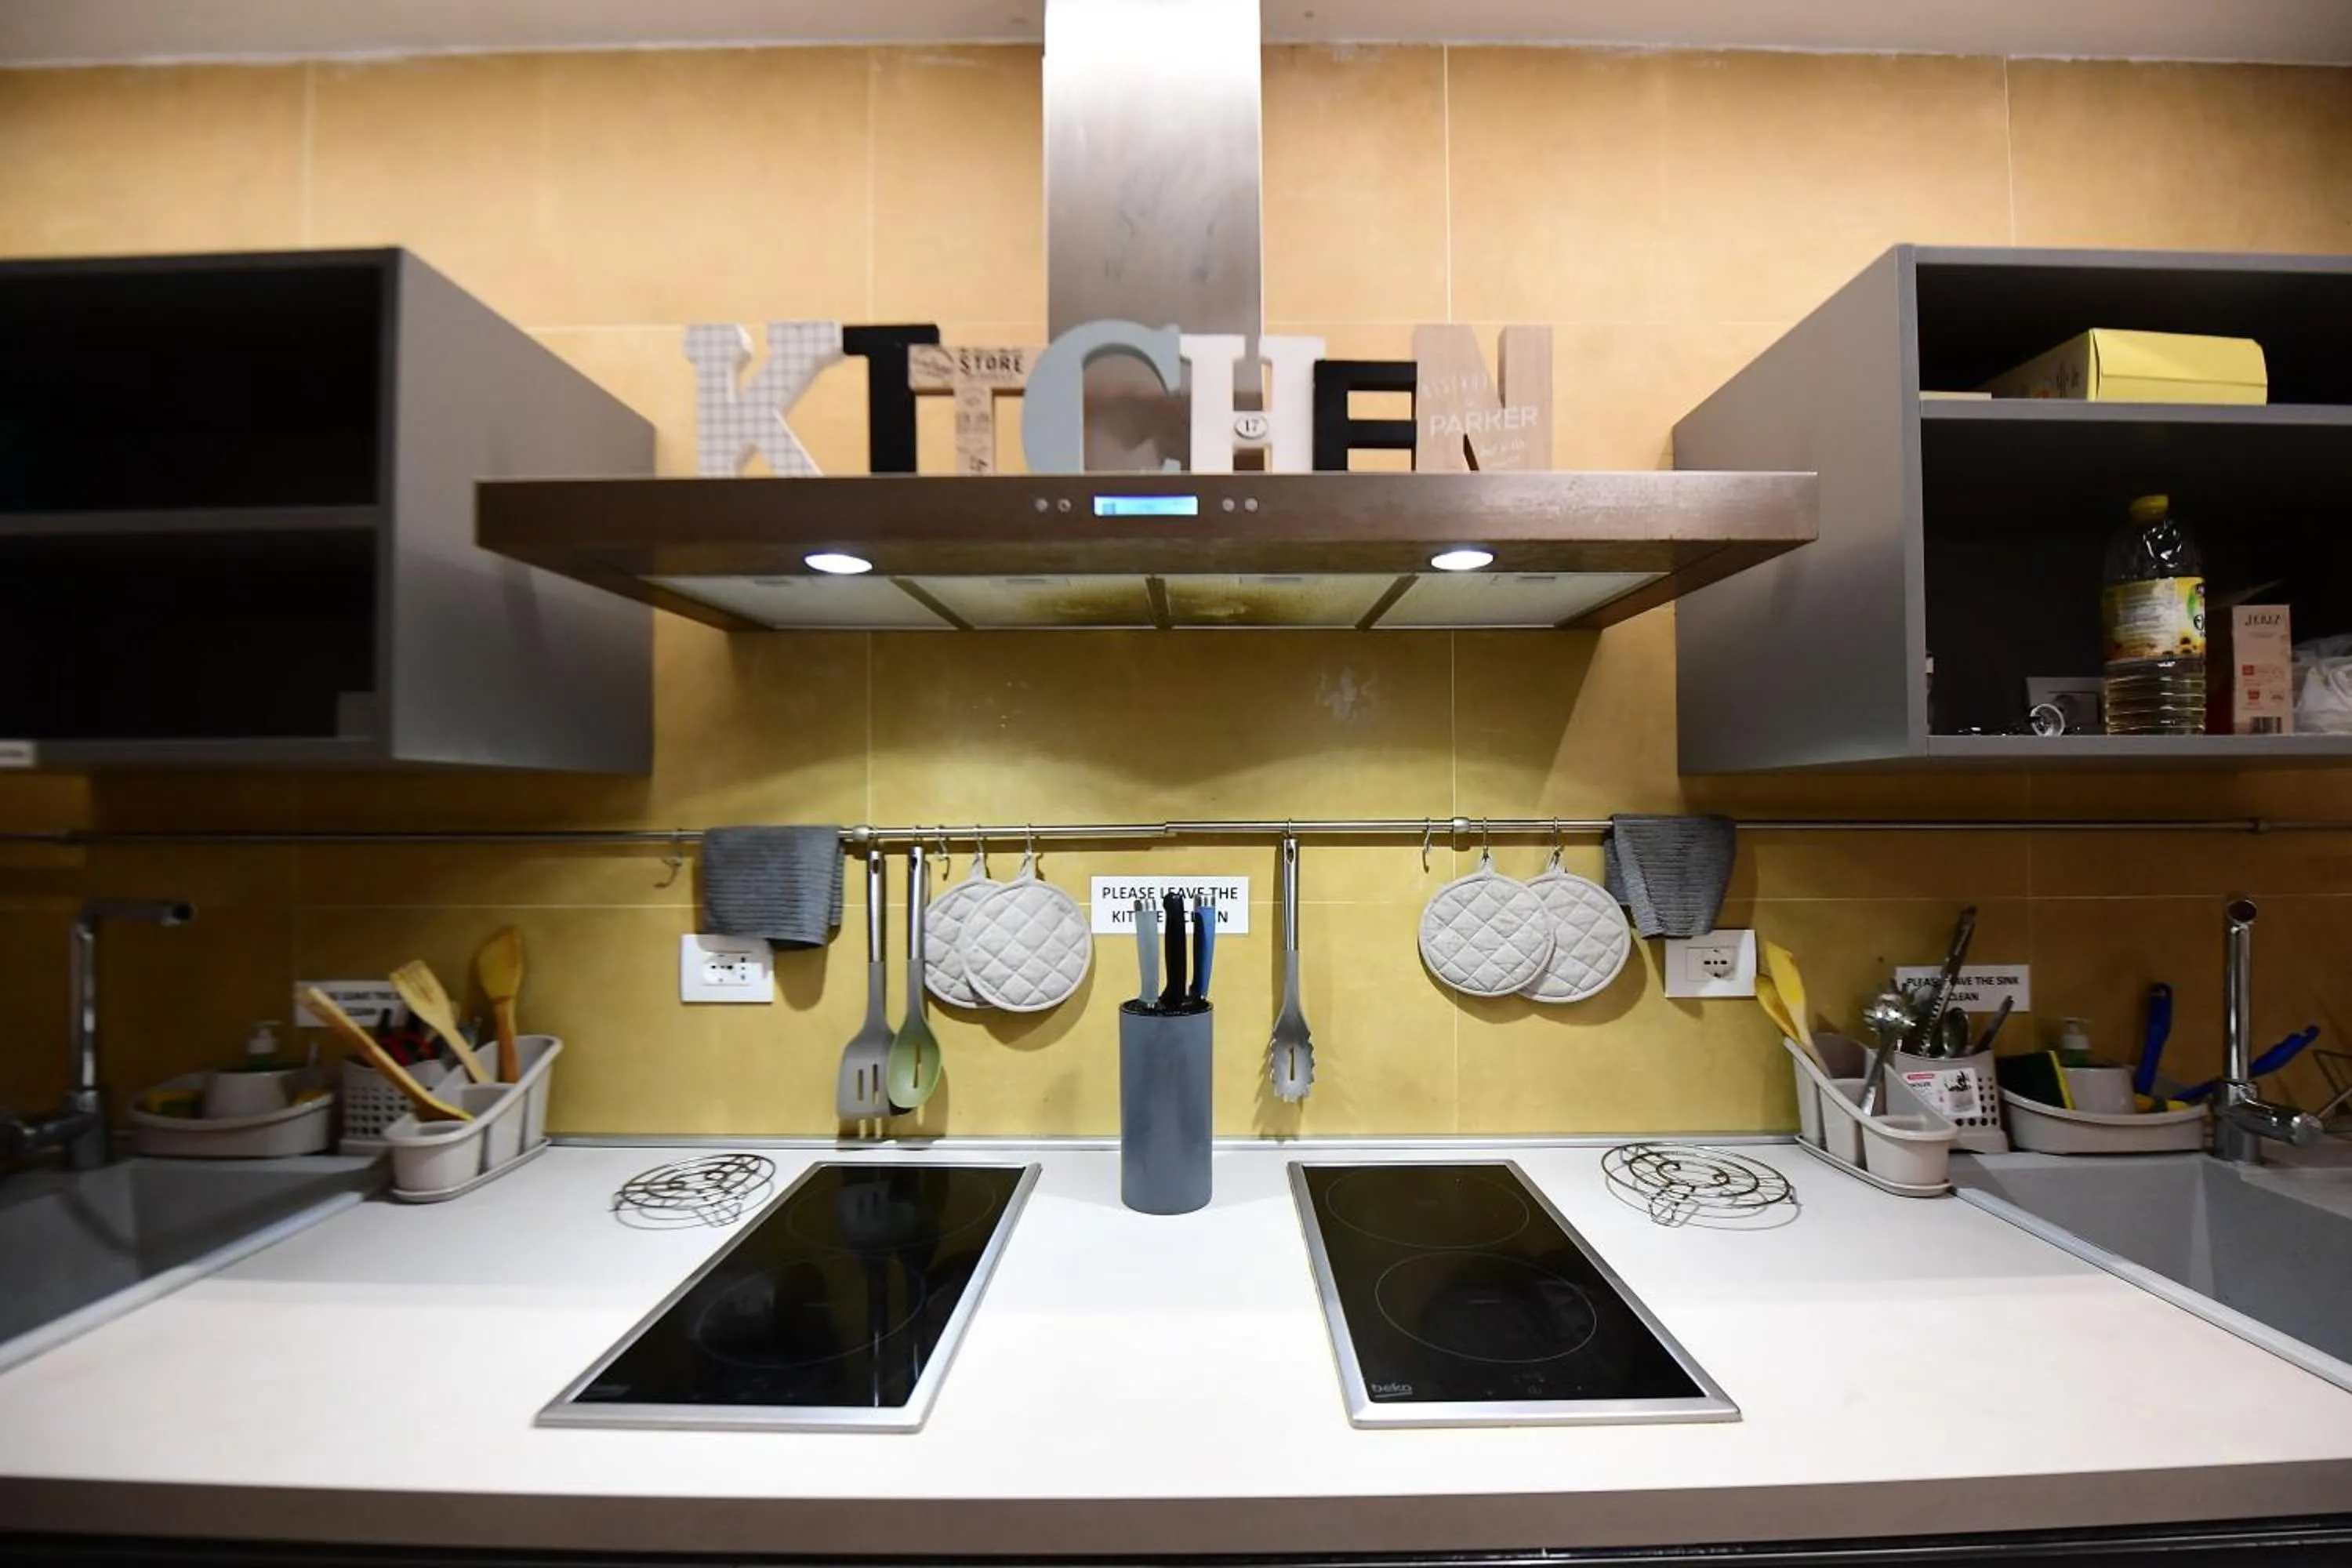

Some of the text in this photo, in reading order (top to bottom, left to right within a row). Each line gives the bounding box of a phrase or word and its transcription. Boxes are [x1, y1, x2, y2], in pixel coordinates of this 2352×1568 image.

[960, 355, 1023, 375] STORE
[1430, 405, 1538, 437] PARKER
[1102, 887, 1155, 899] PLEASE
[1209, 887, 1238, 899] THE
[1112, 910, 1229, 923] KITE CLN
[1906, 977, 1940, 985] PLEAS
[1975, 977, 1995, 985] THE
